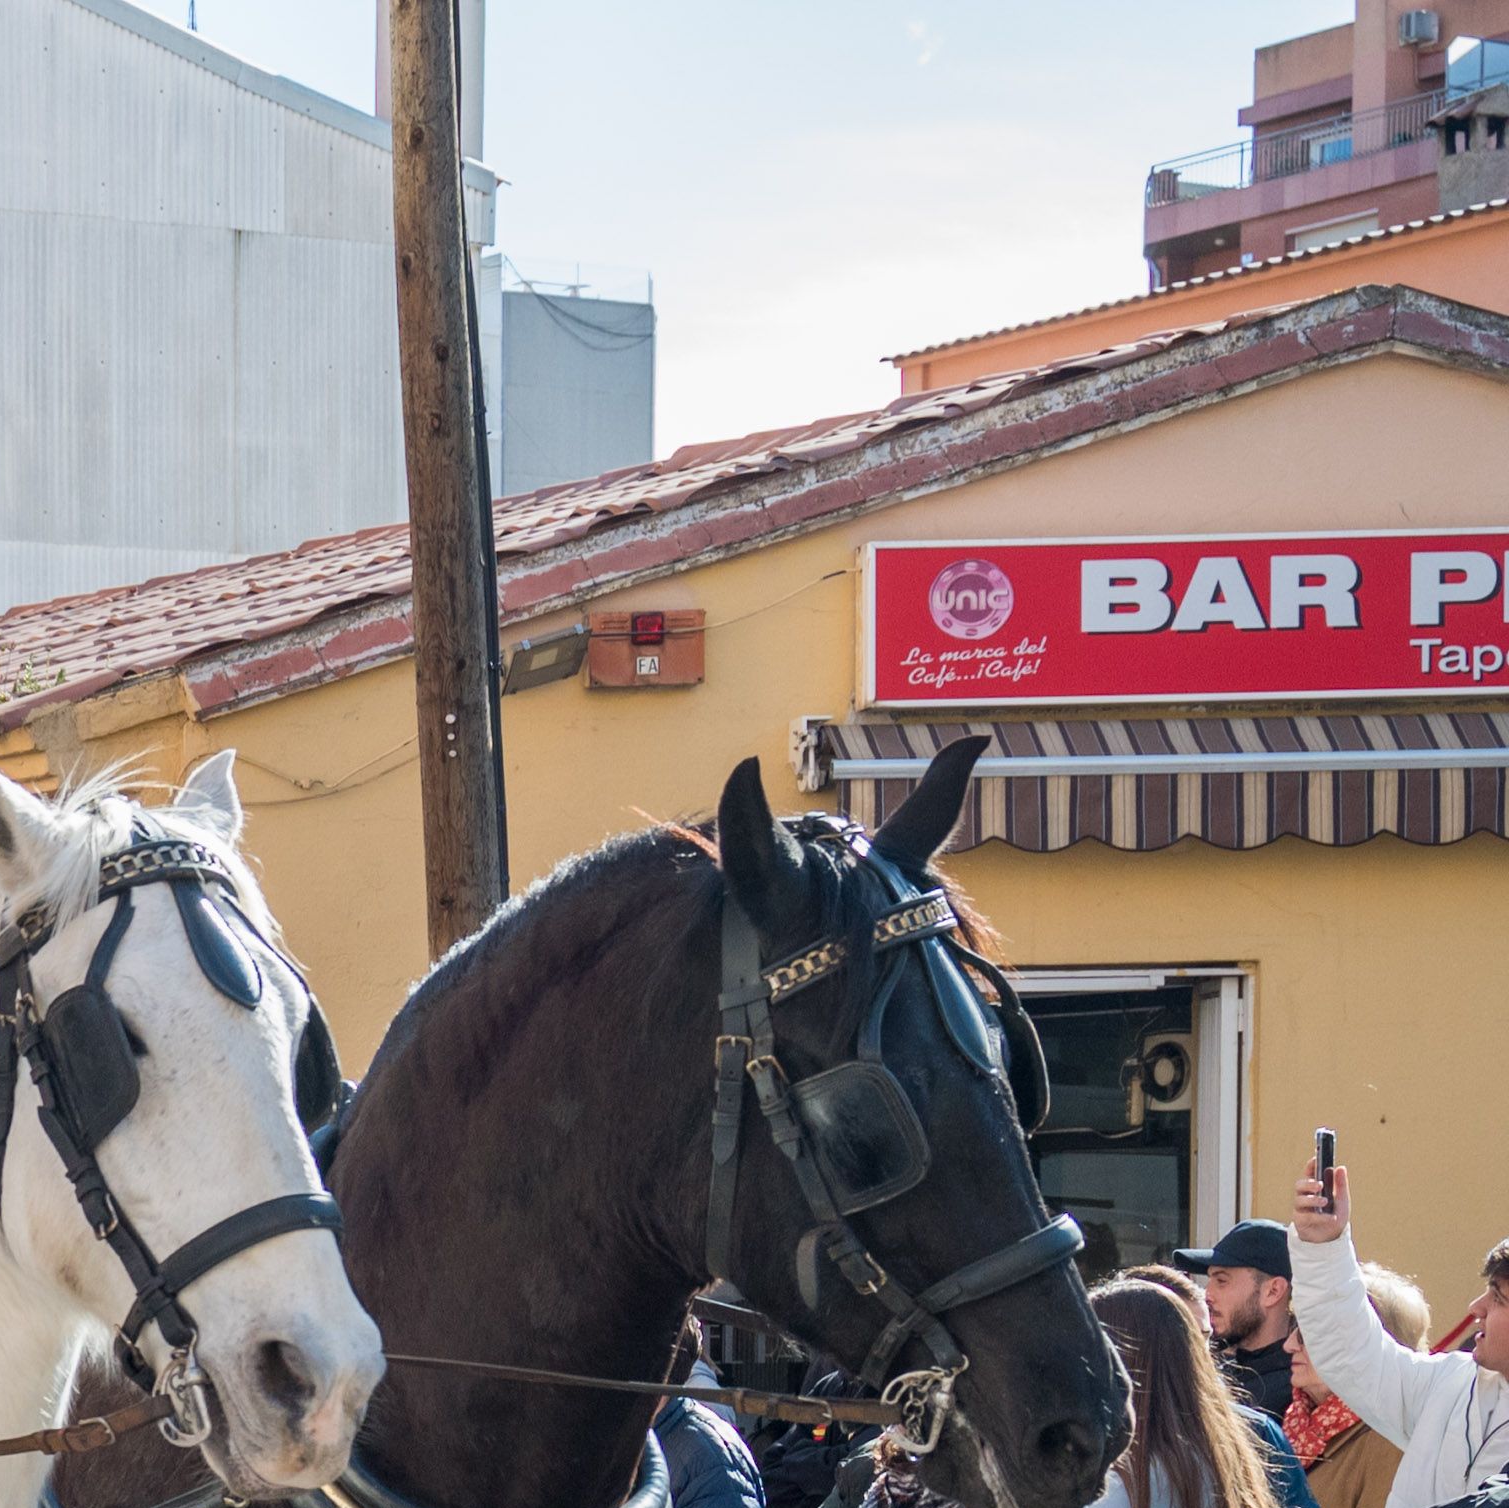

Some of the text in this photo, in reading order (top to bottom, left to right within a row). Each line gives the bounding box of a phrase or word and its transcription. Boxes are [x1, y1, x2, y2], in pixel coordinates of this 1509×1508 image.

[1081, 551, 1509, 634] BAR P
[900, 635, 1047, 666] La marca del
[1409, 637, 1509, 681] Tap
